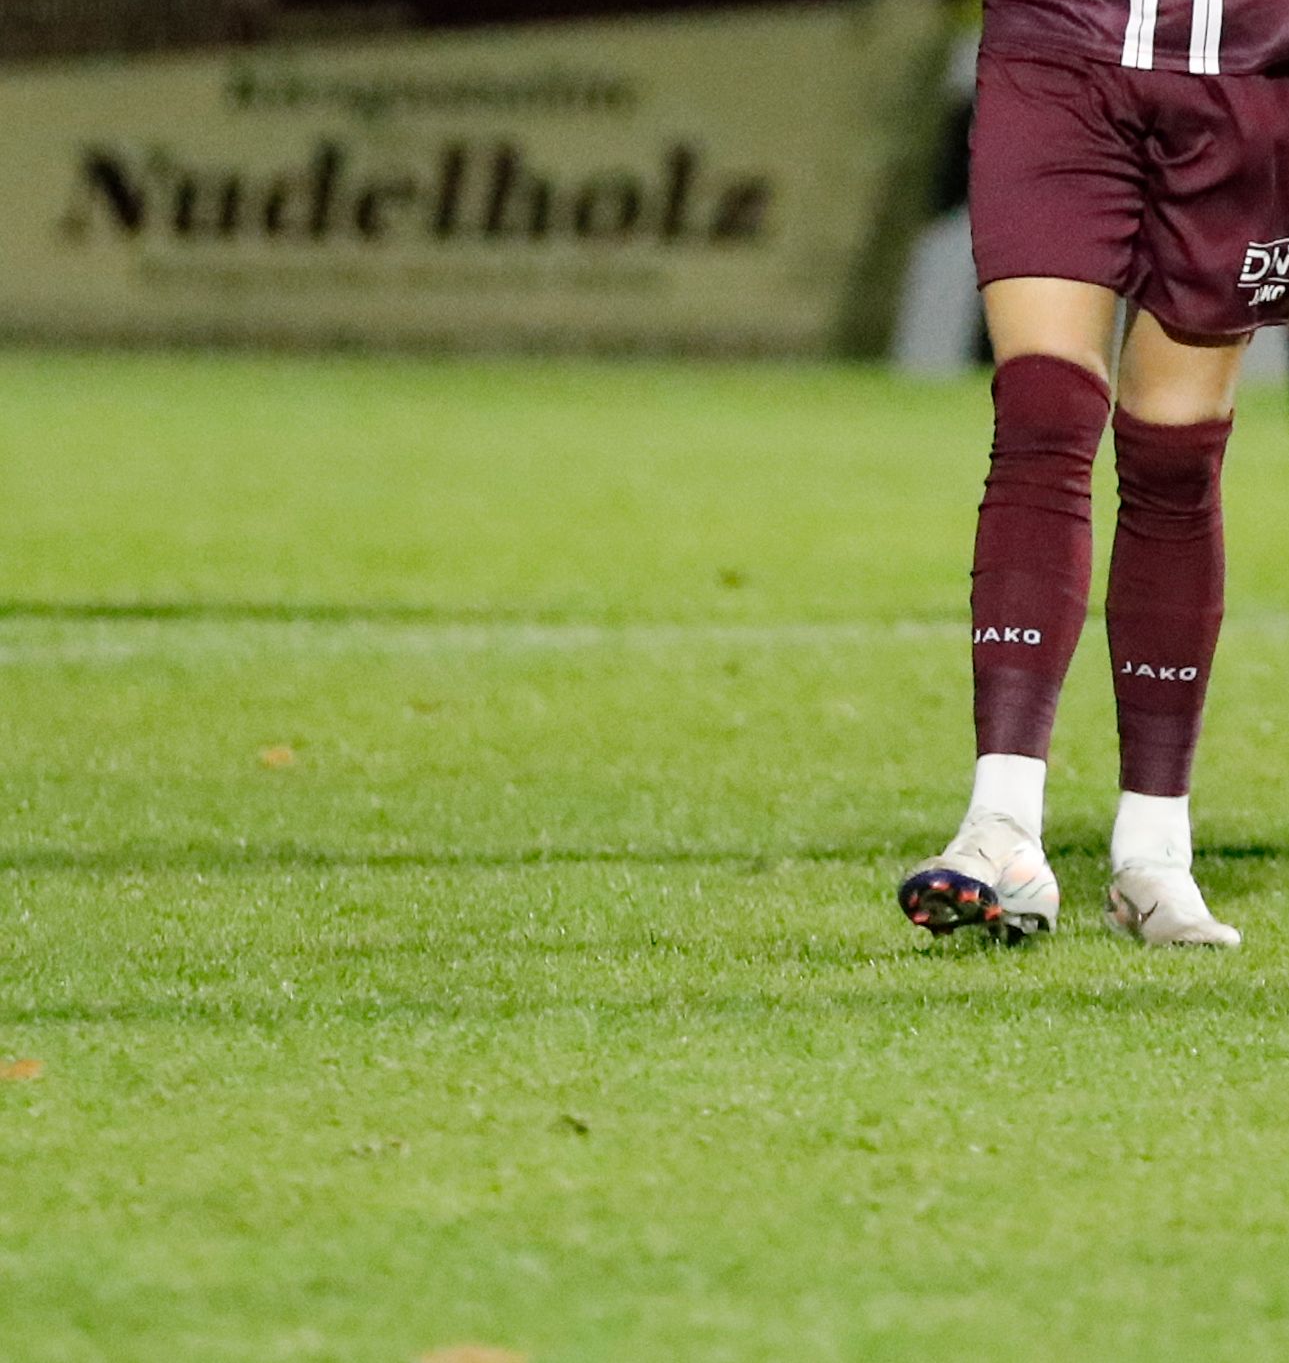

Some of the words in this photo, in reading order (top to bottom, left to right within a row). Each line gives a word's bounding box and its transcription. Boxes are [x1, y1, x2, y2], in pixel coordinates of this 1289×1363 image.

[60, 139, 772, 240] Nudelholz
[973, 627, 1042, 645] JAKO
[1121, 660, 1198, 682] JAKO
